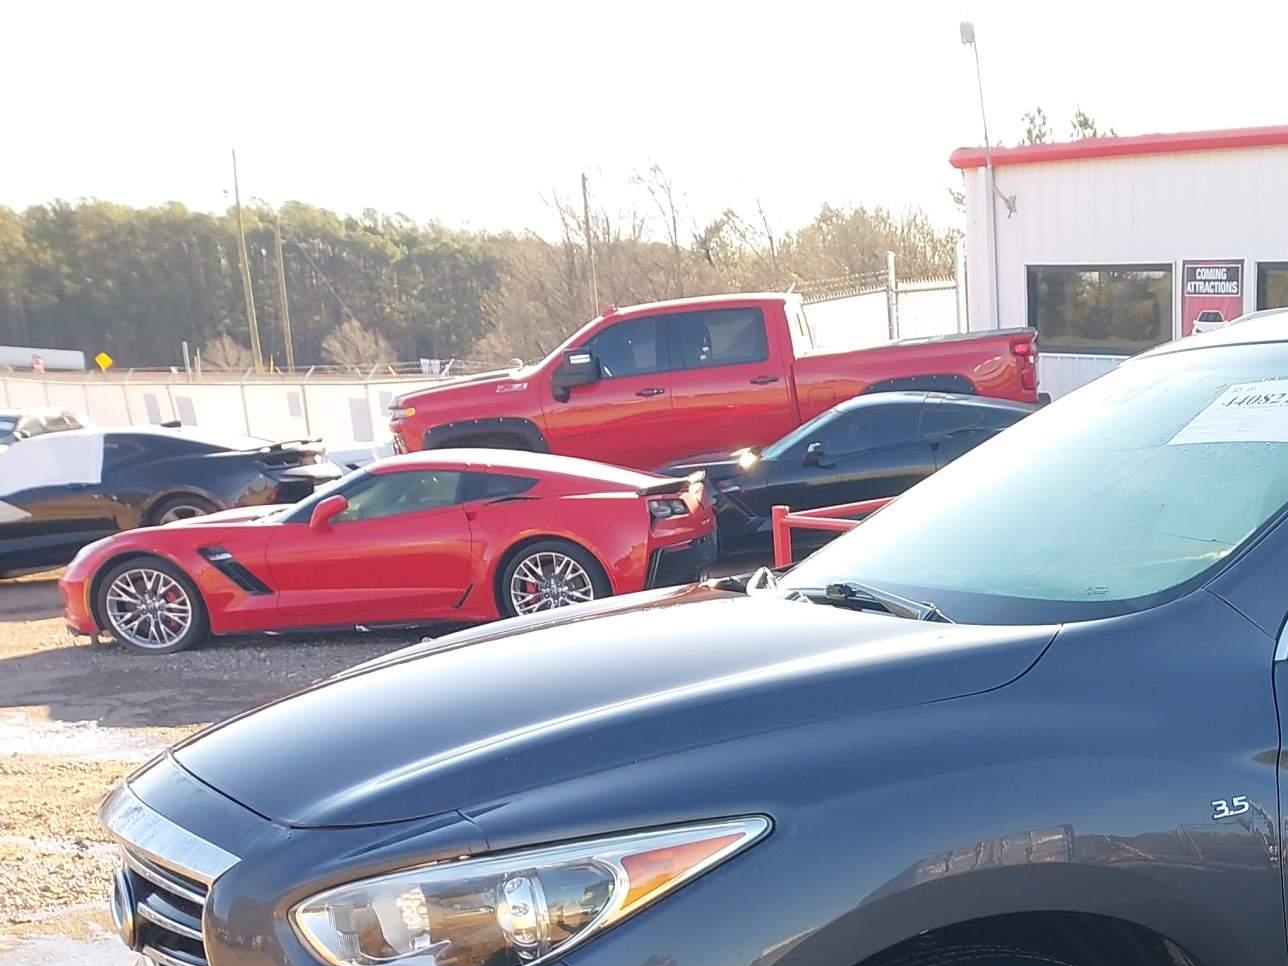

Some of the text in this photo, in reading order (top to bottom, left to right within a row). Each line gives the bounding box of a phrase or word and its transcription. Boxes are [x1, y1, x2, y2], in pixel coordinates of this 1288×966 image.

[1195, 267, 1227, 280] COMING
[1186, 280, 1238, 293] ATTRACTIONS
[1211, 795, 1250, 819] 3.5
